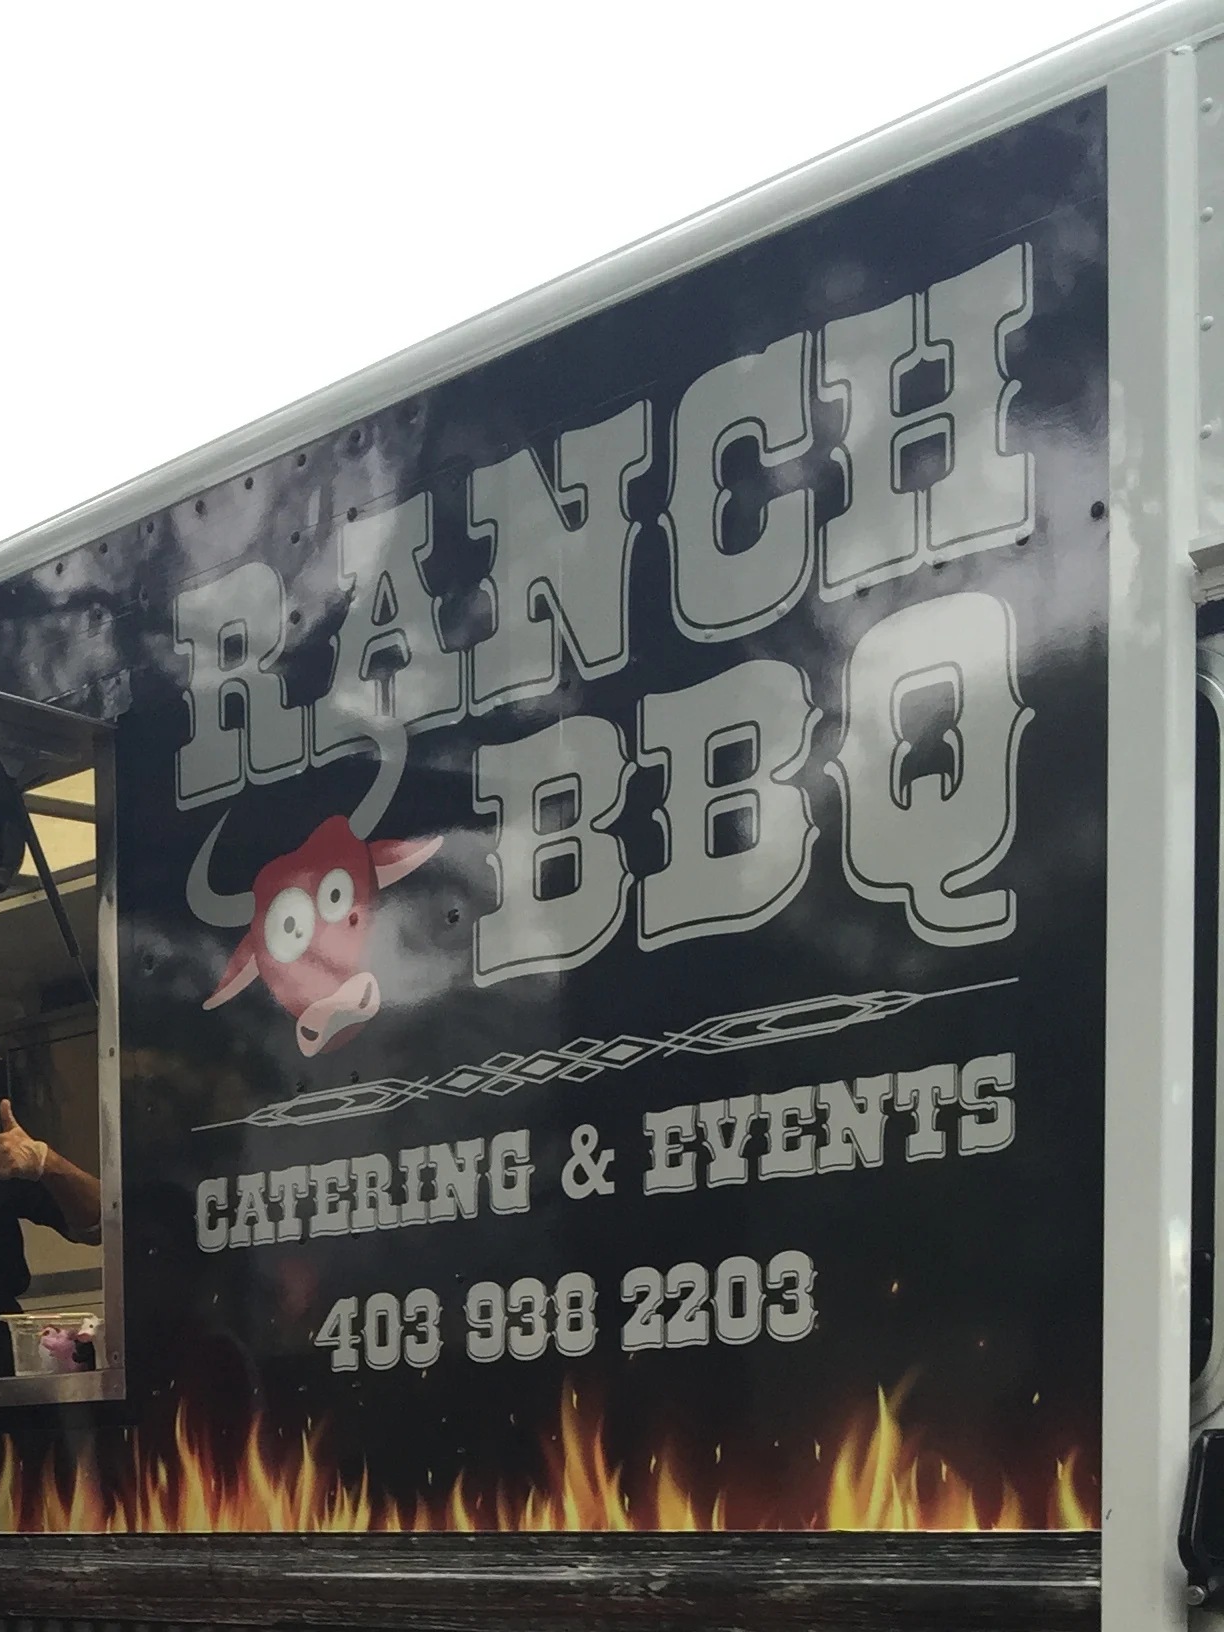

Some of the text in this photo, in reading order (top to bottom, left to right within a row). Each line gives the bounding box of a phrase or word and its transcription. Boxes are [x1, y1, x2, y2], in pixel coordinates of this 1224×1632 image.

[174, 241, 1035, 811] RANCH
[472, 591, 1035, 988] BBQ
[195, 1051, 1017, 1253] CATERING & EVENTS
[315, 1250, 818, 1373] 403 938 2203
